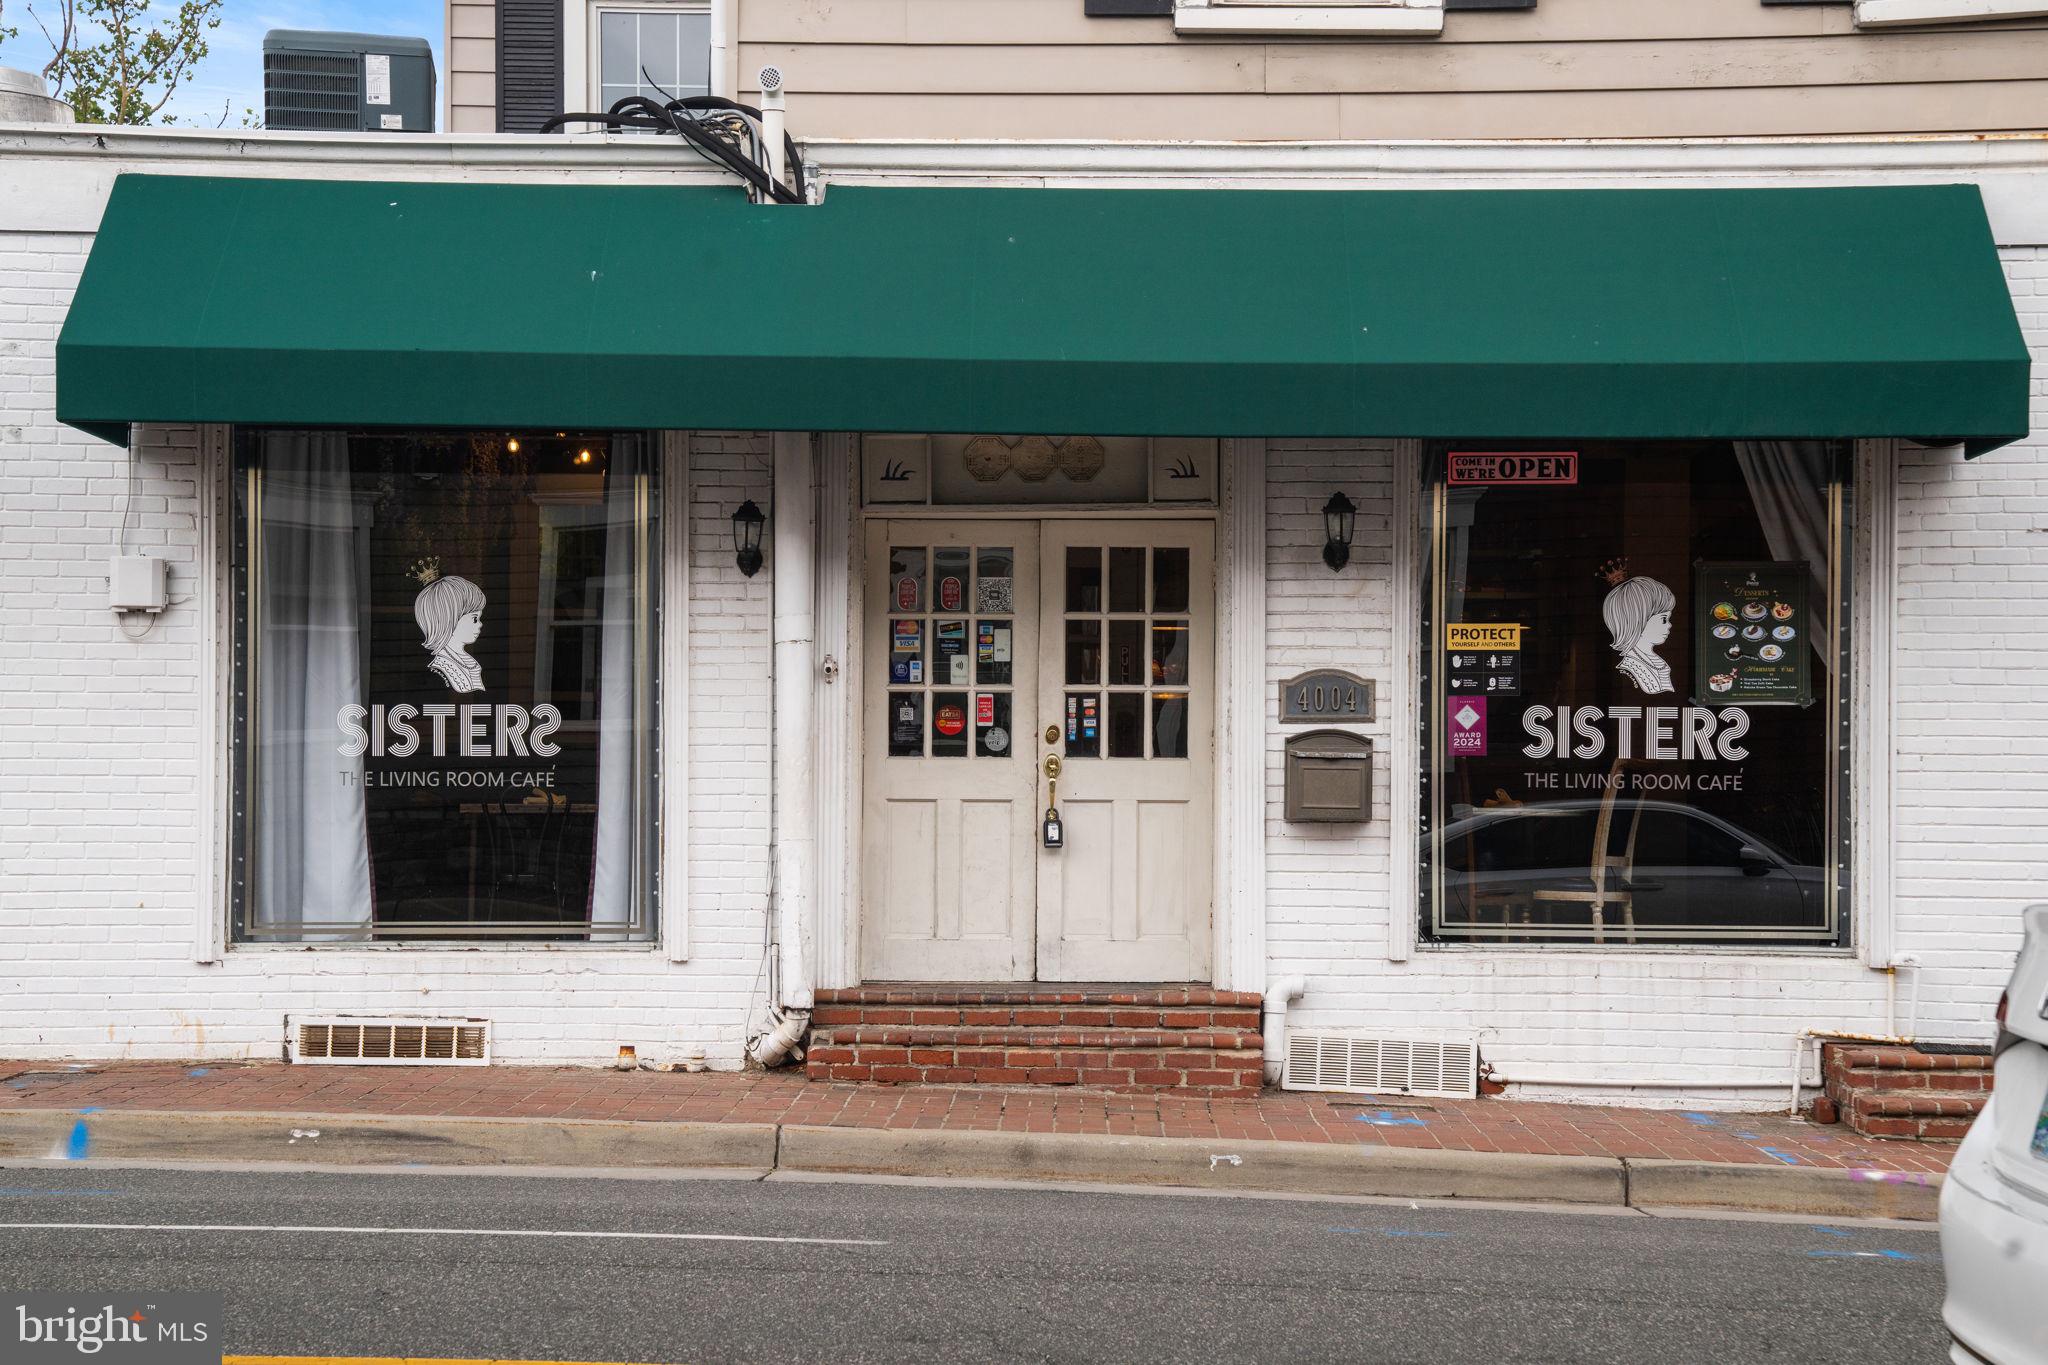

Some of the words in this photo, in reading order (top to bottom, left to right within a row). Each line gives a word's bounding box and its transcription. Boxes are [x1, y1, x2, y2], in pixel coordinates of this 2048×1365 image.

[1455, 458, 1482, 466] COME
[1485, 458, 1496, 466] IN
[1498, 458, 1571, 479] OPEN
[1455, 468, 1496, 479] WE'RE
[1451, 628, 1516, 640] PROTECT
[1297, 686, 1356, 711] 4004
[336, 703, 562, 757] SISTERS
[1522, 704, 1750, 761] SISTERS
[1453, 738, 1482, 746] 2024
[339, 771, 374, 787] THE
[380, 771, 440, 787] LIVING
[446, 771, 504, 787] ROOM
[510, 765, 556, 787] CAFÉ
[1523, 772, 1559, 789] THE
[1565, 773, 1625, 790] LIVING
[1632, 774, 1691, 791] ROOM
[1697, 768, 1744, 791] CAFÉ
